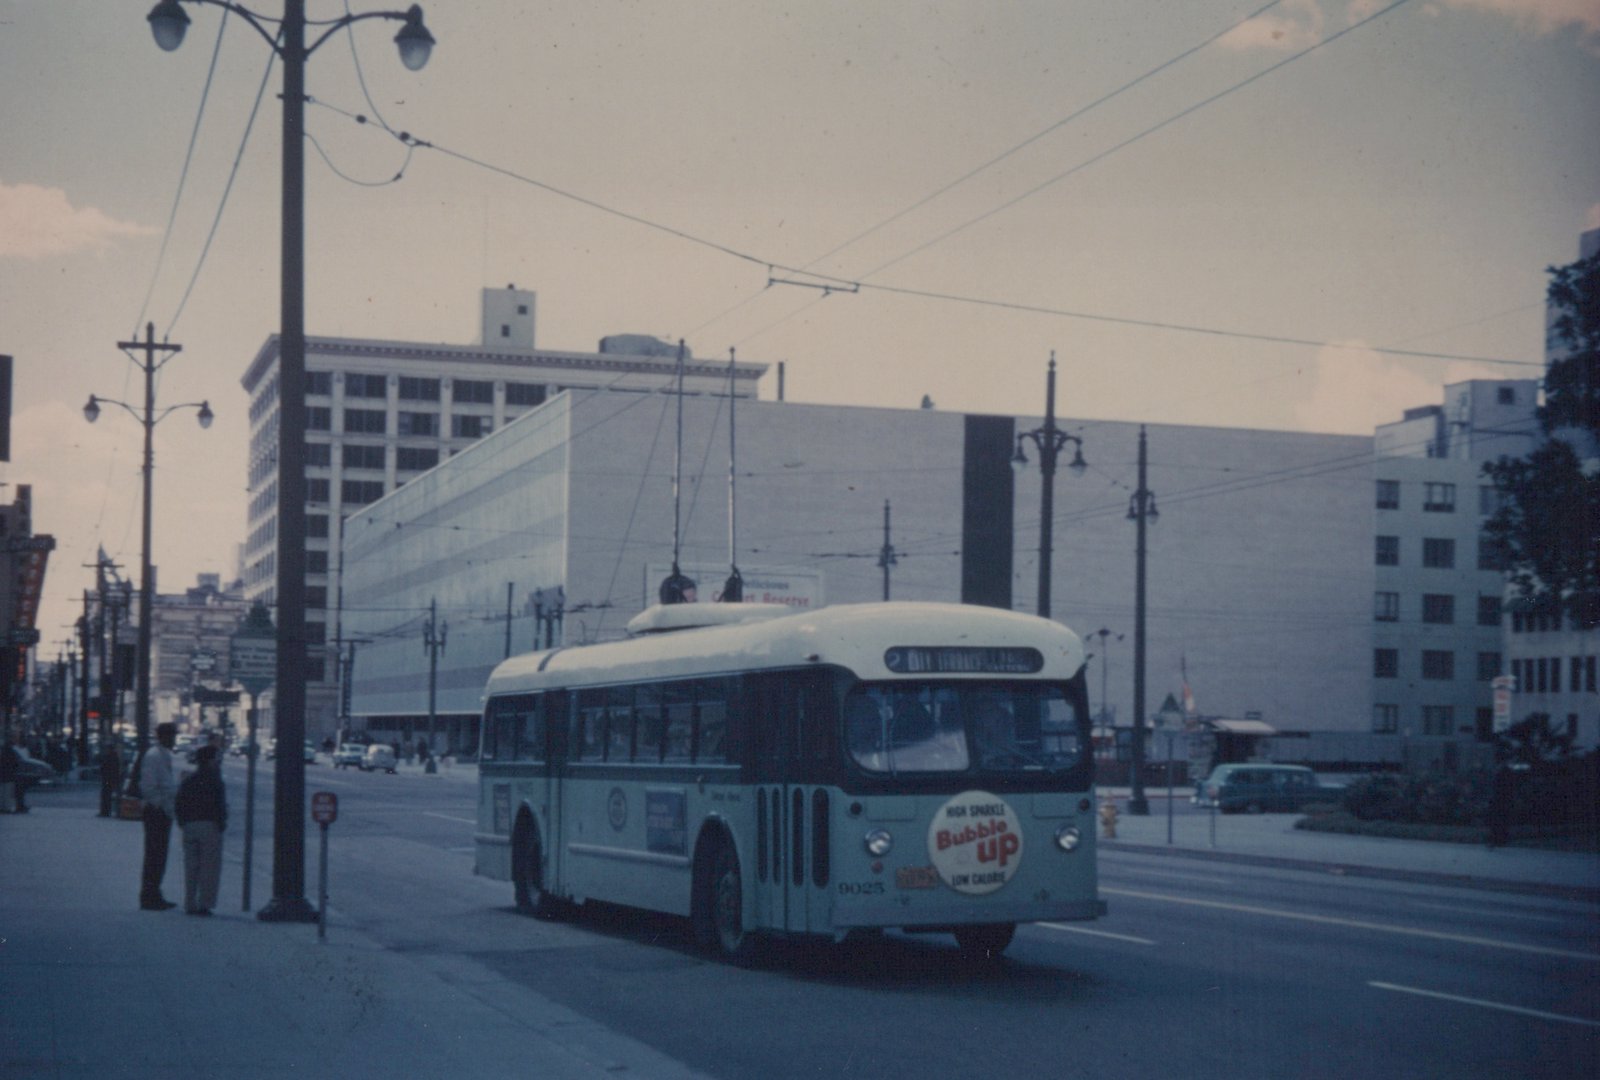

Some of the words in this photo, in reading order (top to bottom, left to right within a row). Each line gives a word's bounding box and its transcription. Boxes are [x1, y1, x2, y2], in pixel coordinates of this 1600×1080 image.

[945, 805, 967, 818] HIGH
[969, 803, 1006, 817] SPARKLE
[936, 818, 1008, 850] Bubble
[951, 873, 970, 886] LOW
[971, 871, 1006, 885] CALORIE
[838, 882, 886, 895] 9025
